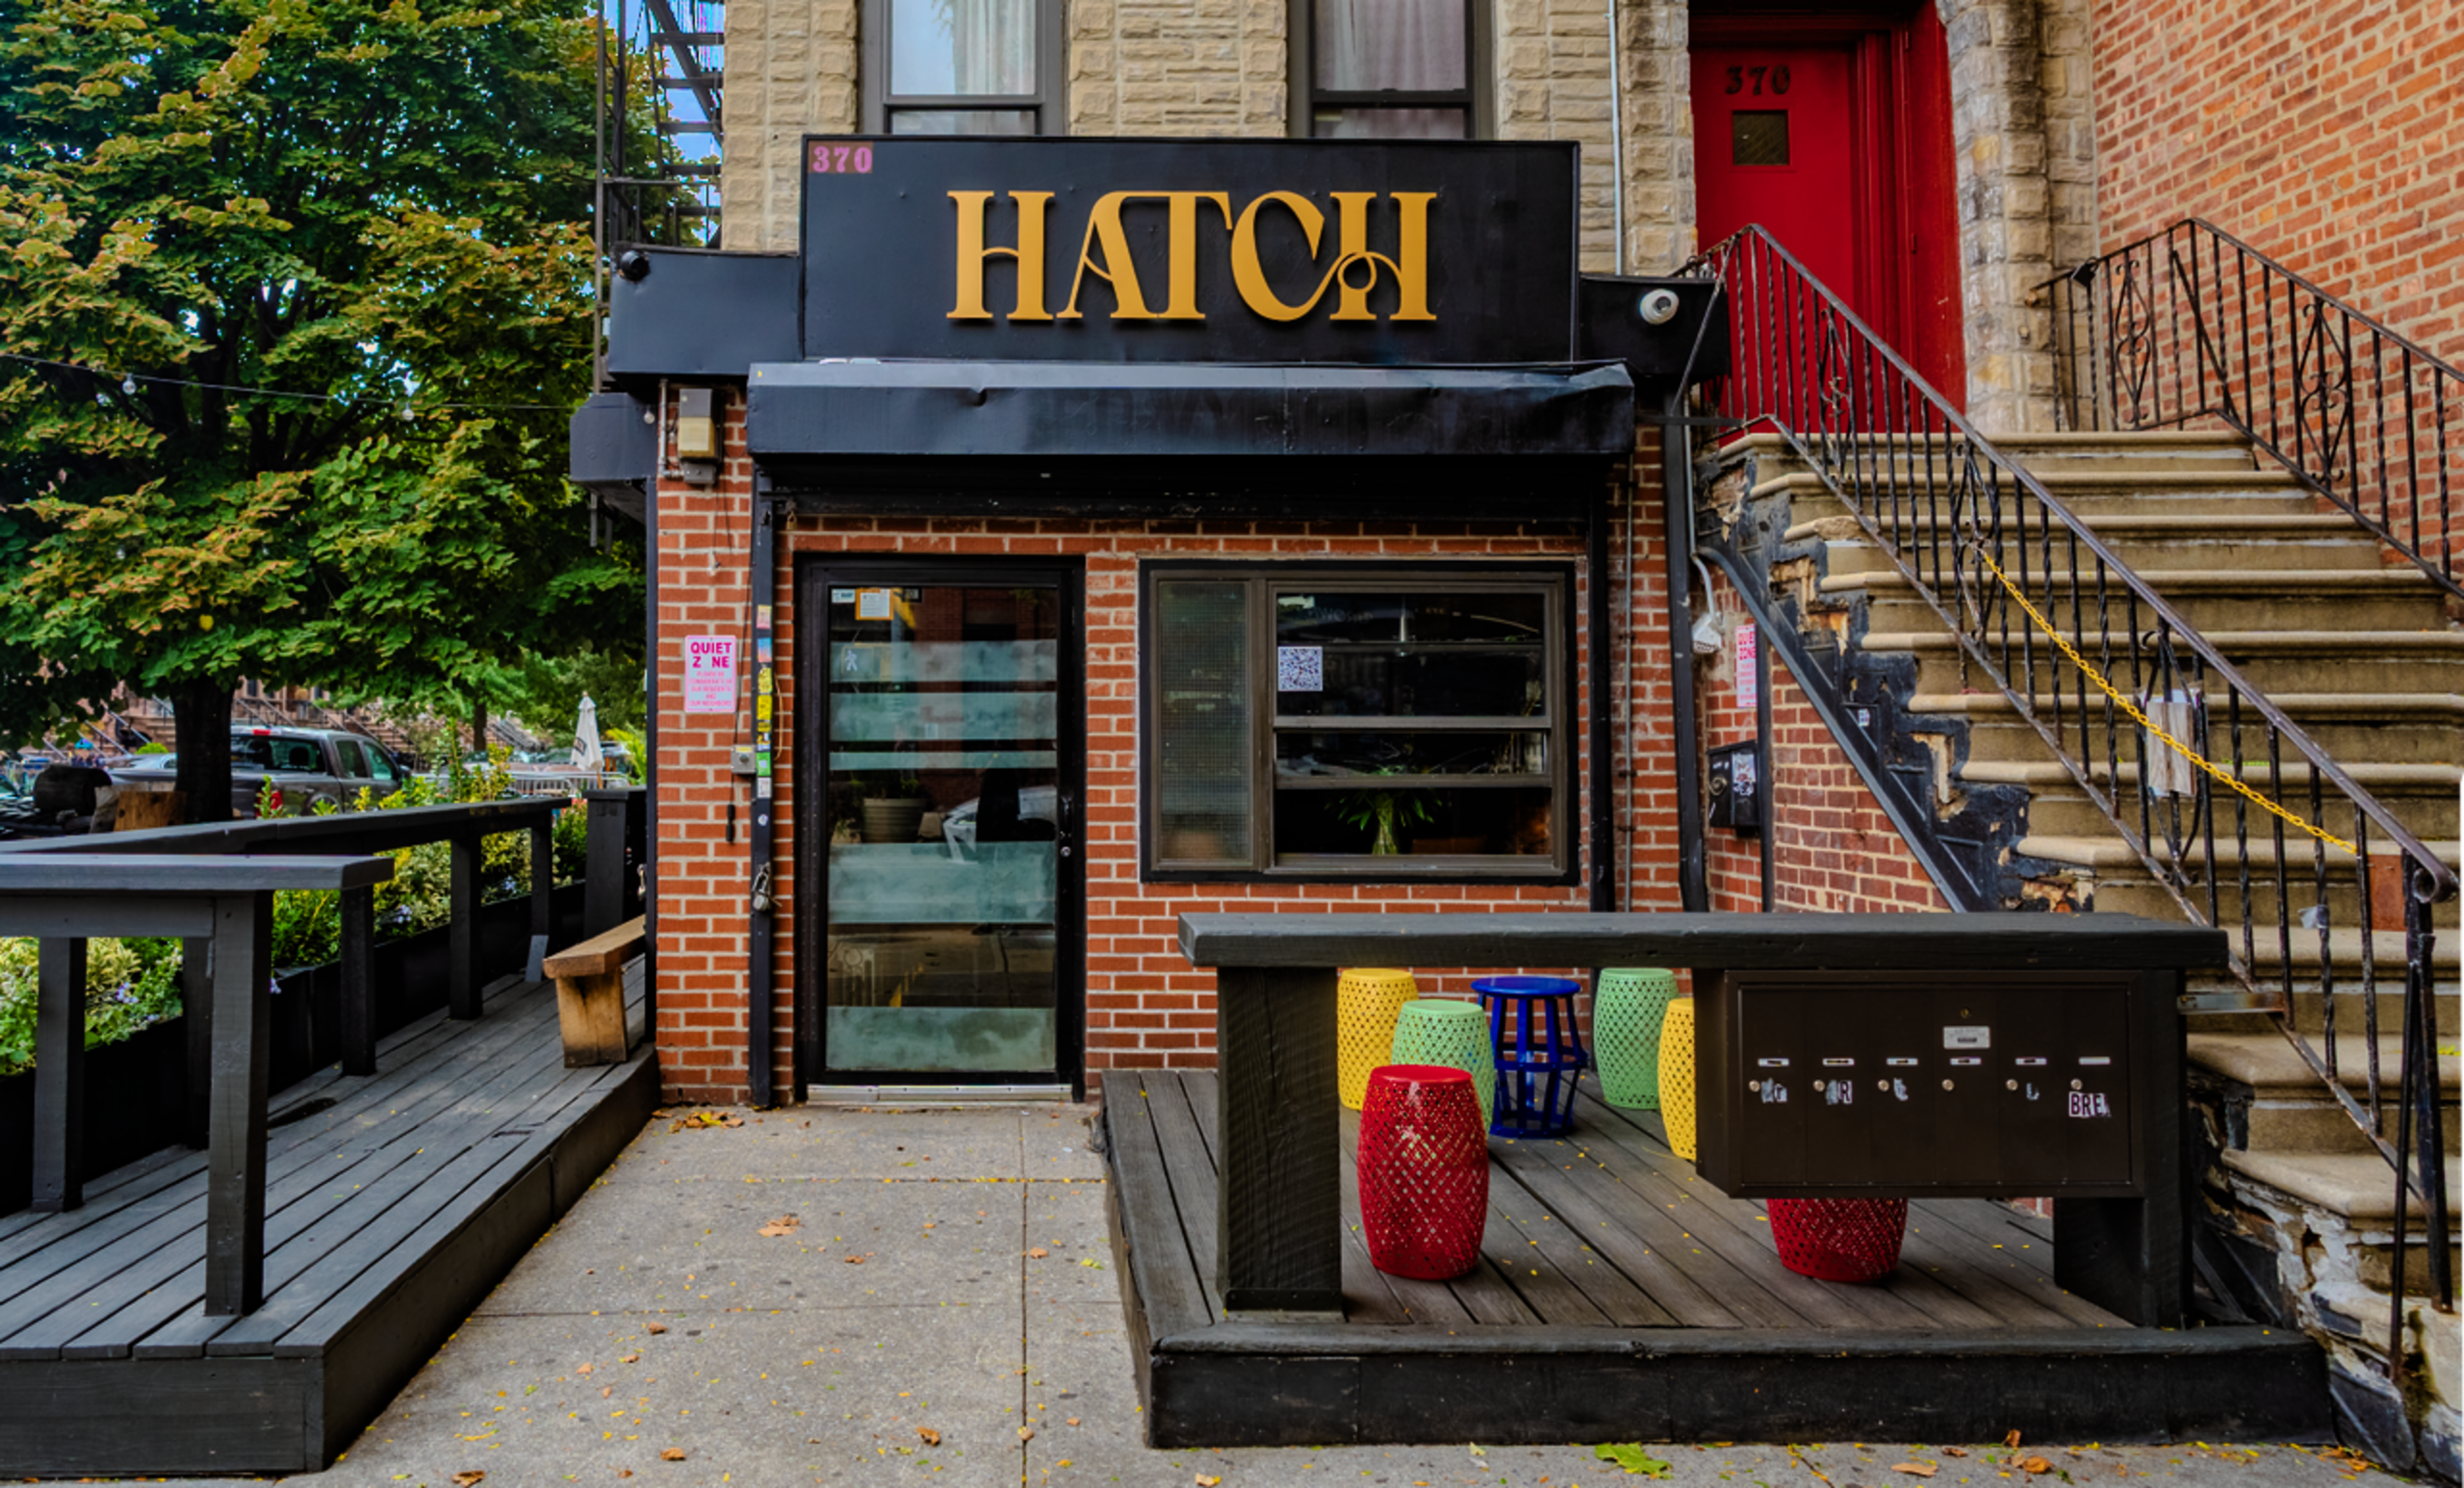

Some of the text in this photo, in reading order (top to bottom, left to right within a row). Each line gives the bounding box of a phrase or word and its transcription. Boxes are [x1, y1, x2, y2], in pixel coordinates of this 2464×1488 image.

[1725, 65, 1791, 96] 370
[813, 146, 872, 173] 370
[947, 191, 1437, 320] HATCH
[690, 642, 732, 654] QUIET
[692, 656, 730, 668] ZNE
